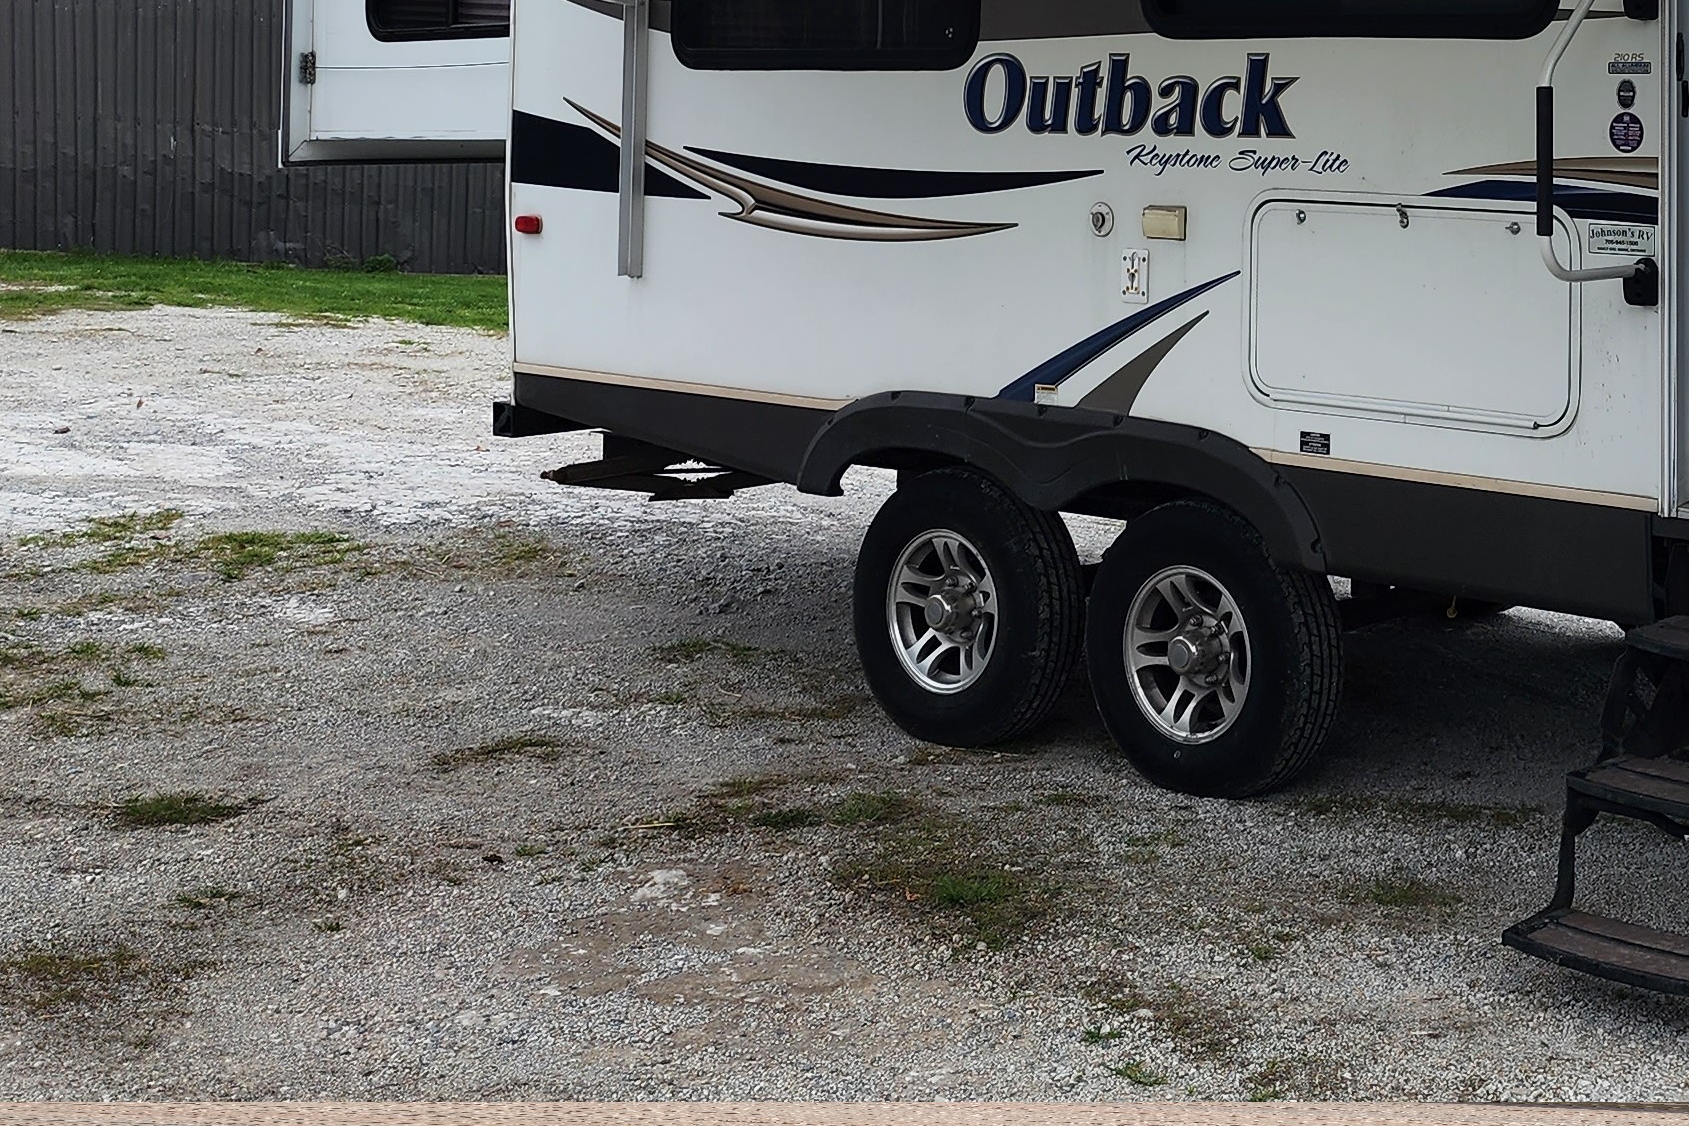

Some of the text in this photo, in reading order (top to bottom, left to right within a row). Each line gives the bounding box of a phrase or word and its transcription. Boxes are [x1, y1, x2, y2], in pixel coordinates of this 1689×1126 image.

[964, 52, 1300, 138] Outback
[1125, 144, 1350, 177] Keystone Super-Lite
[1590, 228, 1653, 242] Johnson's RV
